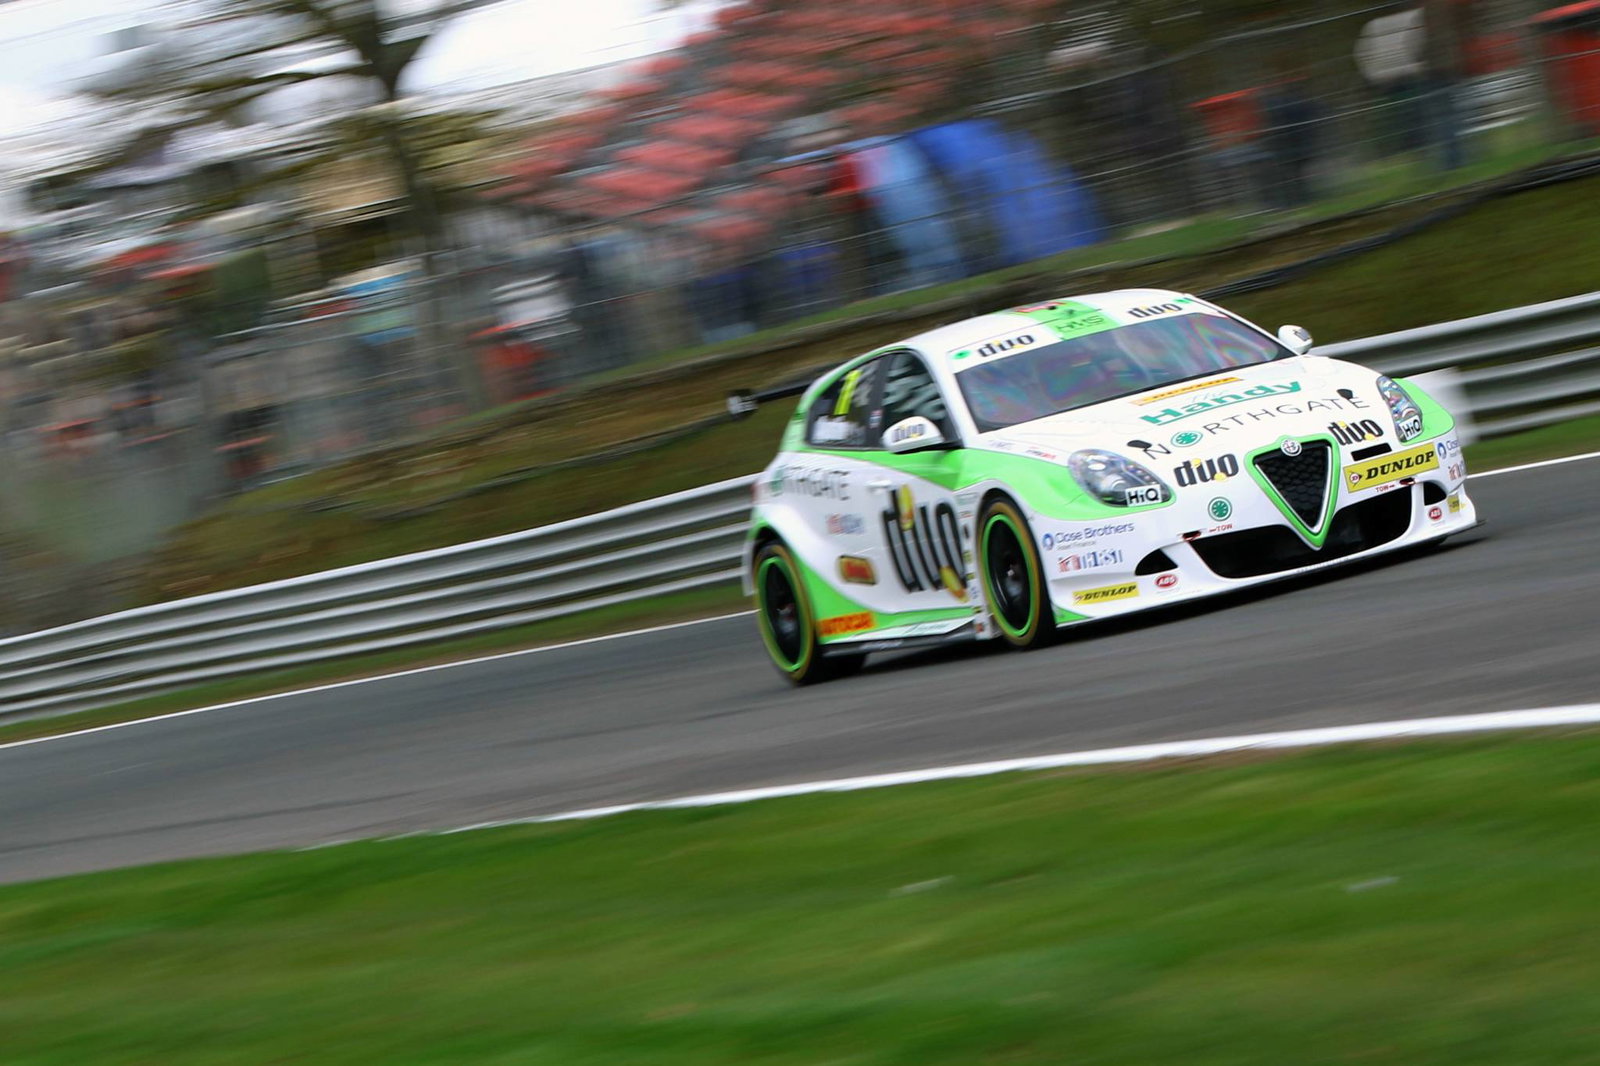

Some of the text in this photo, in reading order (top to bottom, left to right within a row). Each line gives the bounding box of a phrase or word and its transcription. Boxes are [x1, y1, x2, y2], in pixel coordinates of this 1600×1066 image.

[1127, 302, 1183, 319] duo
[977, 334, 1035, 357] duo
[1139, 379, 1302, 424] Handy
[1327, 419, 1384, 446] duo
[1402, 419, 1421, 438] HiQ
[1174, 453, 1239, 487] duo
[1365, 451, 1434, 480] DUNLOP
[1128, 487, 1159, 504] HiQ
[882, 486, 968, 594] duo
[1084, 523, 1135, 539] Brothers
[1084, 585, 1137, 600] DUNLOP
